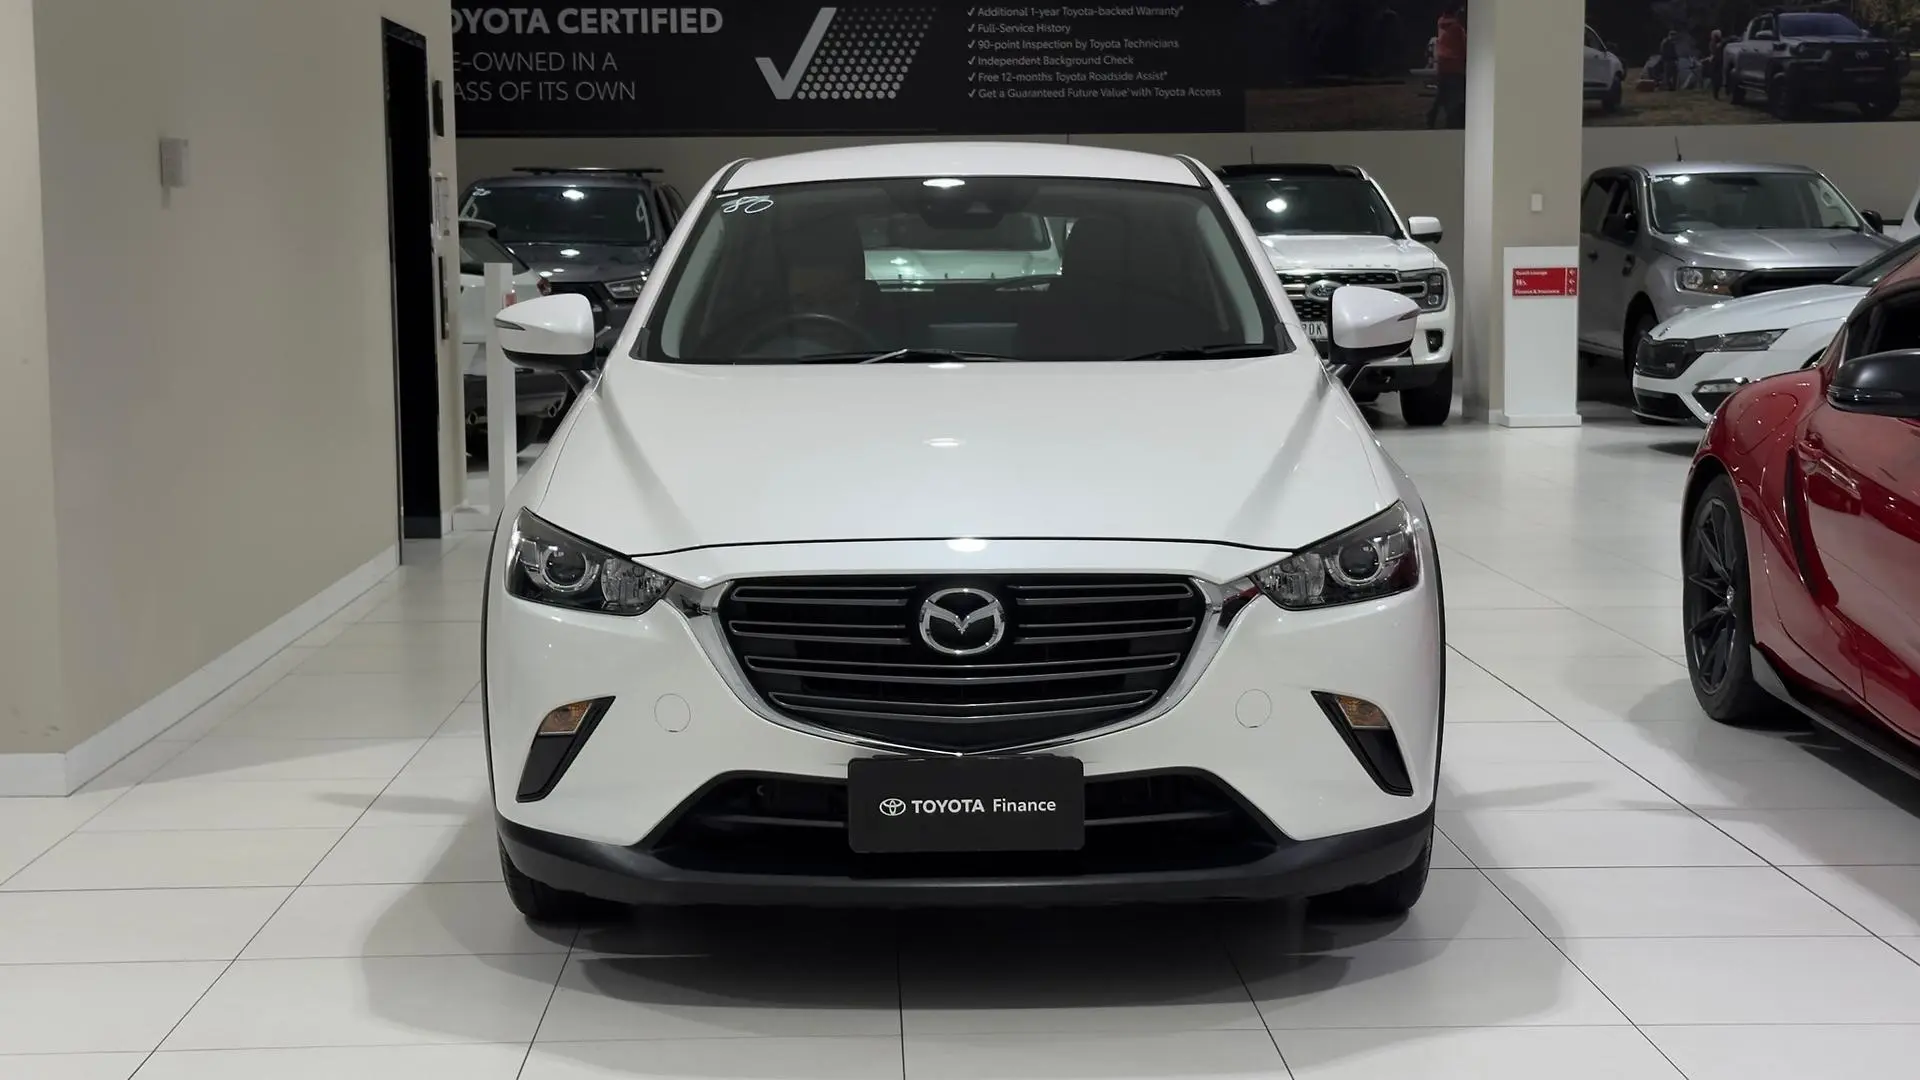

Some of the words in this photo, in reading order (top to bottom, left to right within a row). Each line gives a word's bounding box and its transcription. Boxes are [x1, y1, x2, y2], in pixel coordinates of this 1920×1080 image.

[978, 7, 1028, 17] Additional
[1031, 7, 1060, 19] 1-year
[1063, 6, 1133, 18] Toyota-backed
[557, 7, 723, 34] CERTIFIED
[978, 23, 1034, 33] Full-Service
[1037, 23, 1071, 34] History
[978, 39, 1020, 51] 90-point
[1022, 39, 1072, 51] Inspection
[1075, 38, 1088, 50] by
[1090, 38, 1121, 51] Toyota
[1124, 38, 1179, 49] Technicians
[573, 52, 594, 71] IN
[602, 52, 618, 71] A
[978, 56, 1041, 67] Independent
[1043, 55, 1101, 67] Background
[1103, 54, 1134, 65] Check
[978, 72, 999, 82] Free
[1002, 71, 1052, 82] 12-months
[1056, 71, 1086, 83] Toyota
[1089, 70, 1133, 81] Roadside
[499, 81, 532, 101] OF
[539, 81, 568, 101] ITS
[575, 81, 636, 101] OWN
[978, 88, 996, 98] Get
[999, 90, 1006, 98] a
[1008, 88, 1065, 99] Guaranteed
[1068, 87, 1098, 98] Future
[1131, 87, 1151, 97] with
[1154, 86, 1185, 98] Toyota
[1188, 86, 1222, 97] Access
[911, 799, 985, 814] TOYOTA
[993, 798, 1056, 812] Finance
